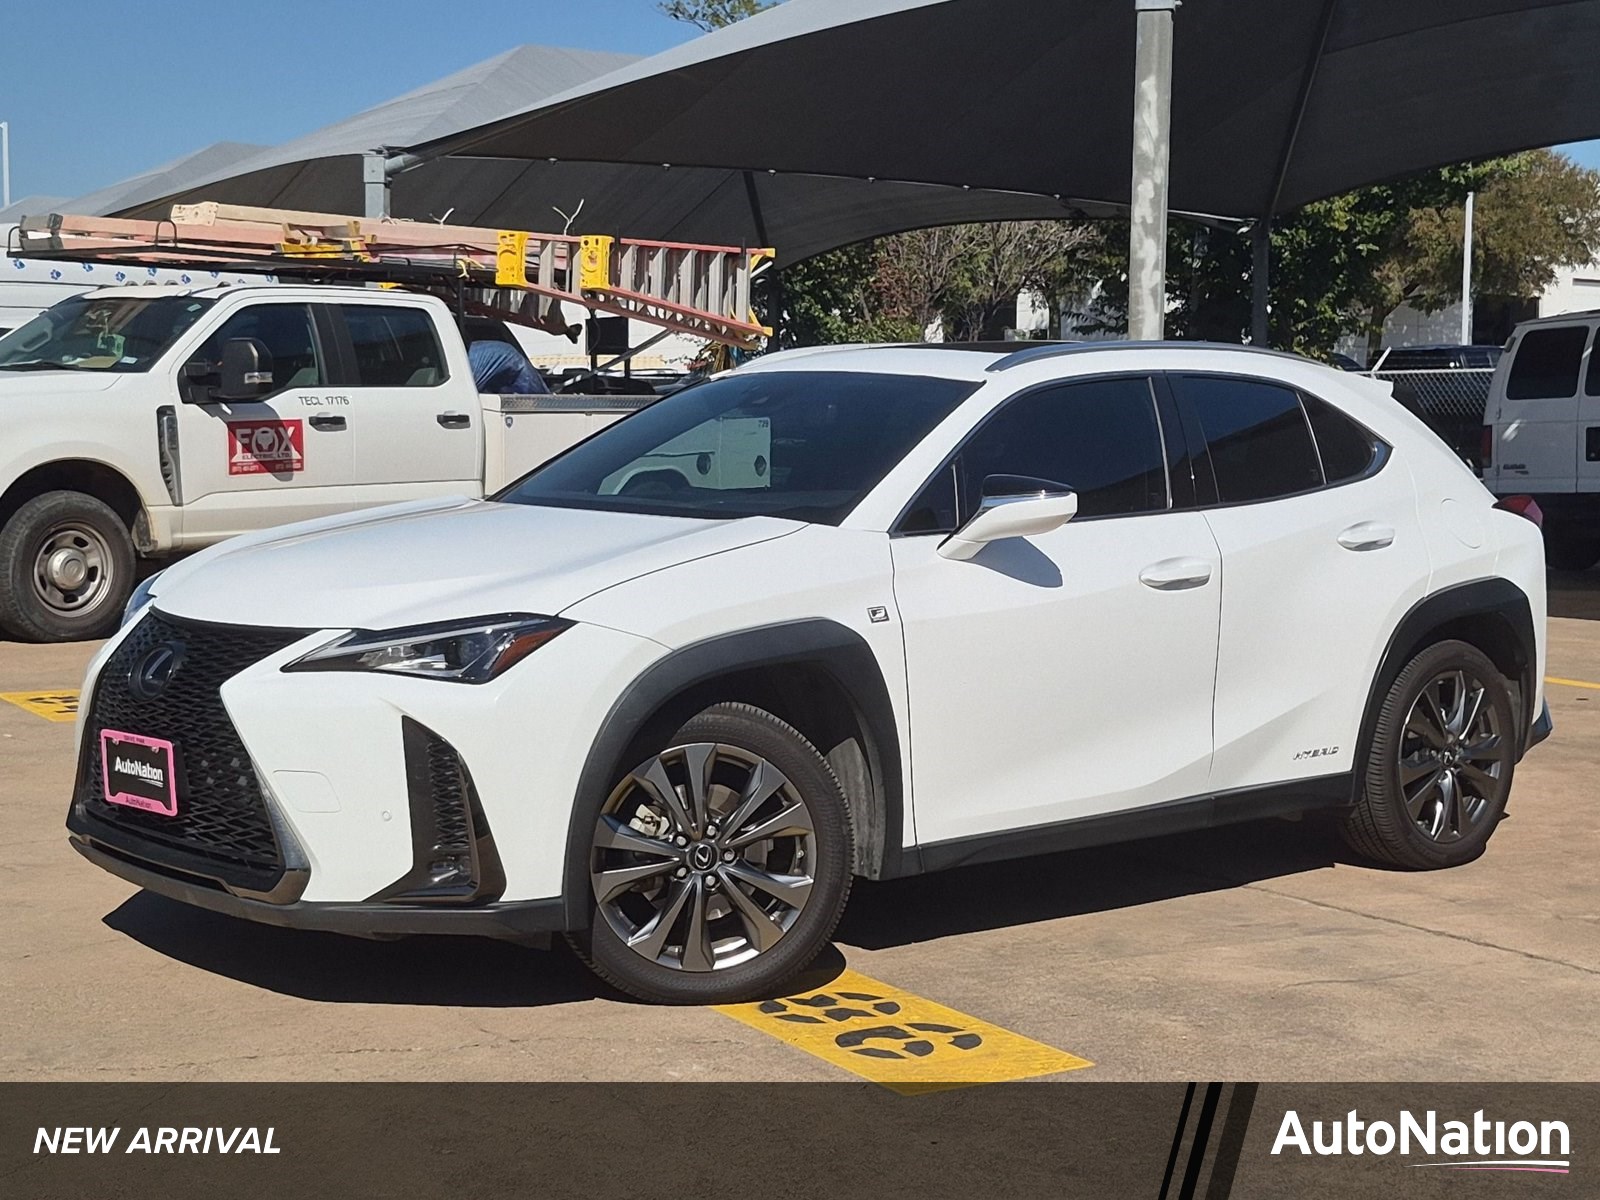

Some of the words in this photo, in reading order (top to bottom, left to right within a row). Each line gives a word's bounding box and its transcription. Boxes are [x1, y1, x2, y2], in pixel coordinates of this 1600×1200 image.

[299, 396, 324, 406] TECL
[325, 395, 350, 405] 17176
[231, 426, 302, 462] FOX
[114, 756, 164, 781] AutoNation
